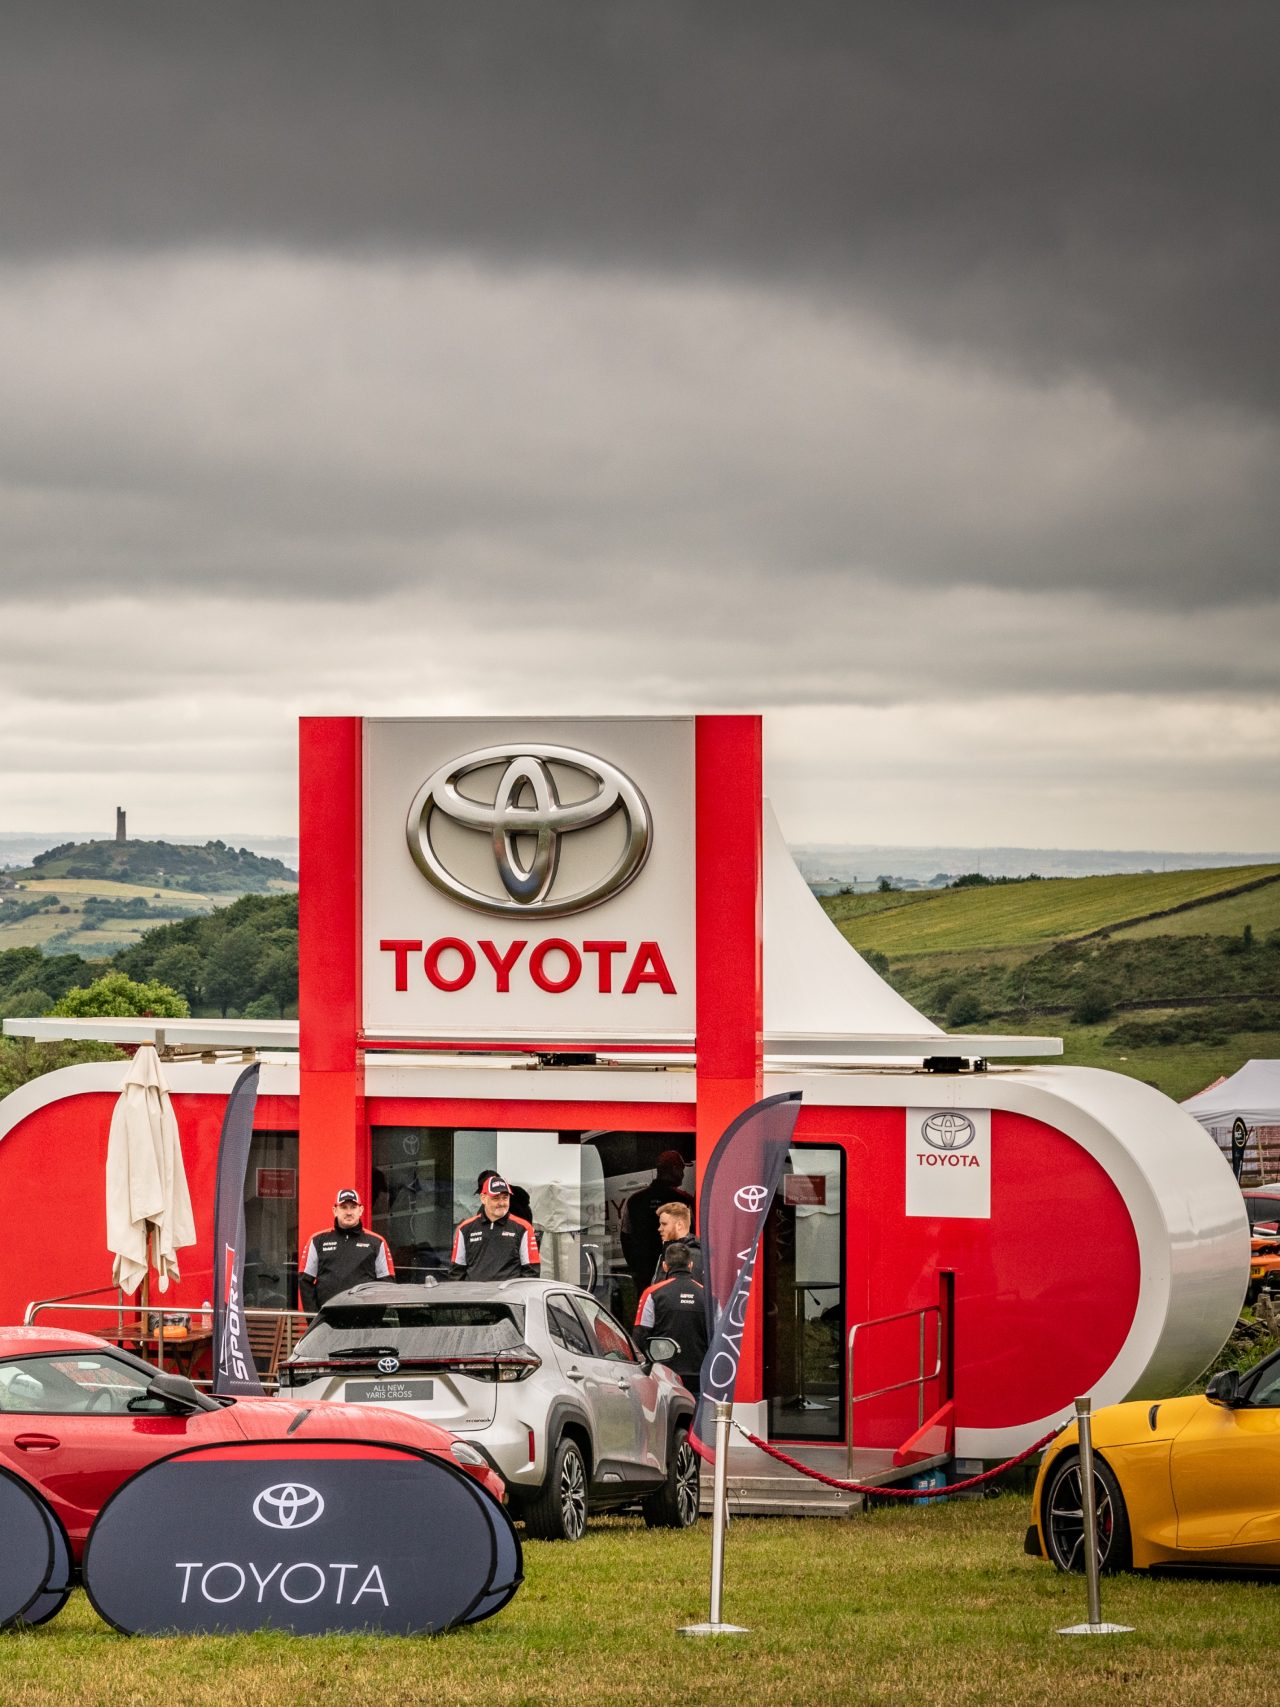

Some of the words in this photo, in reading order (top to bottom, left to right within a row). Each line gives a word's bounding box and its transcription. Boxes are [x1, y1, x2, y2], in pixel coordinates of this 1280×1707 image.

[380, 937, 677, 995] TOYOTA
[916, 1153, 980, 1167] TOYOTA
[230, 1270, 249, 1381] SPORT
[365, 1391, 386, 1399] YARIS
[388, 1390, 413, 1398] CROSS
[387, 1384, 405, 1392] NEW
[175, 1562, 390, 1607] TOYOTA
